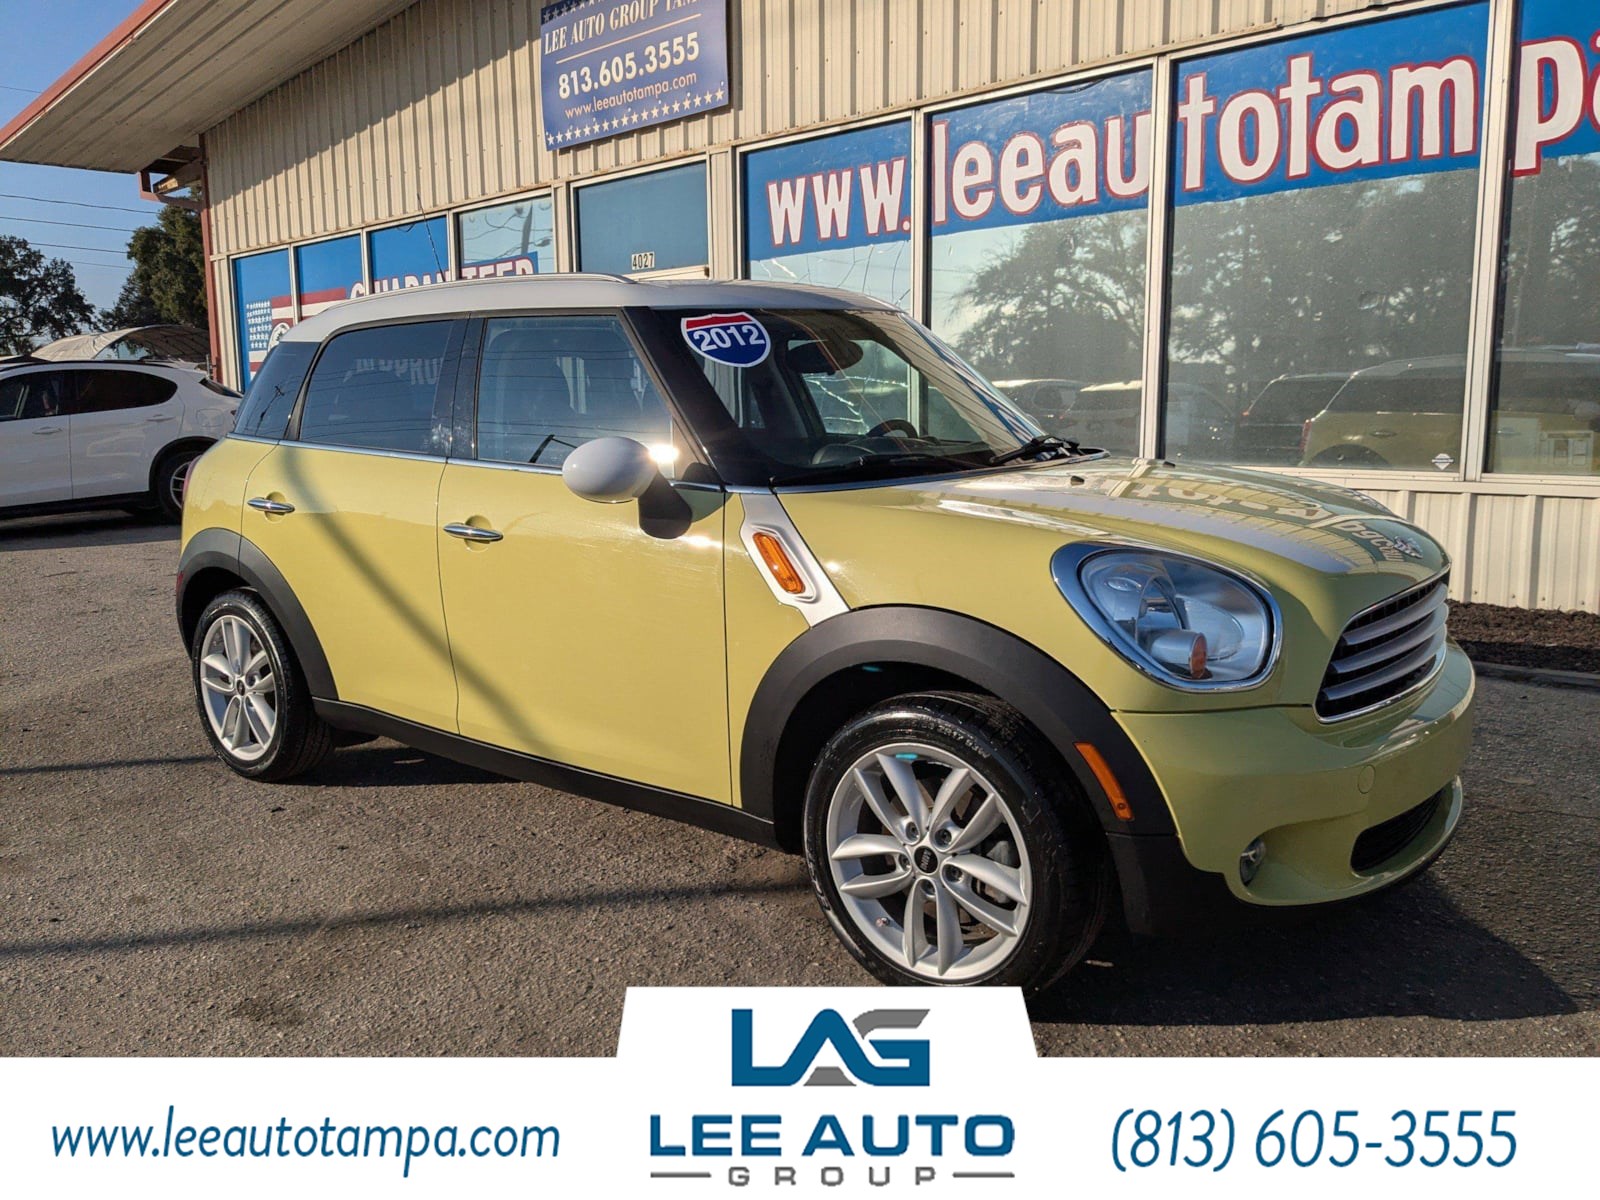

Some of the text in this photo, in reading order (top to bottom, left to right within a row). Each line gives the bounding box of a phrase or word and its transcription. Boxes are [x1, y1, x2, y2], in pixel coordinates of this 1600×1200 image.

[544, 0, 660, 55] LEE AUTO GROUP
[558, 31, 700, 99] 813.605.3555
[564, 72, 698, 119] www.leeautotampa.com
[767, 28, 1600, 247] www.leeautotamp
[632, 252, 654, 269] 4027
[692, 324, 766, 352] 2012
